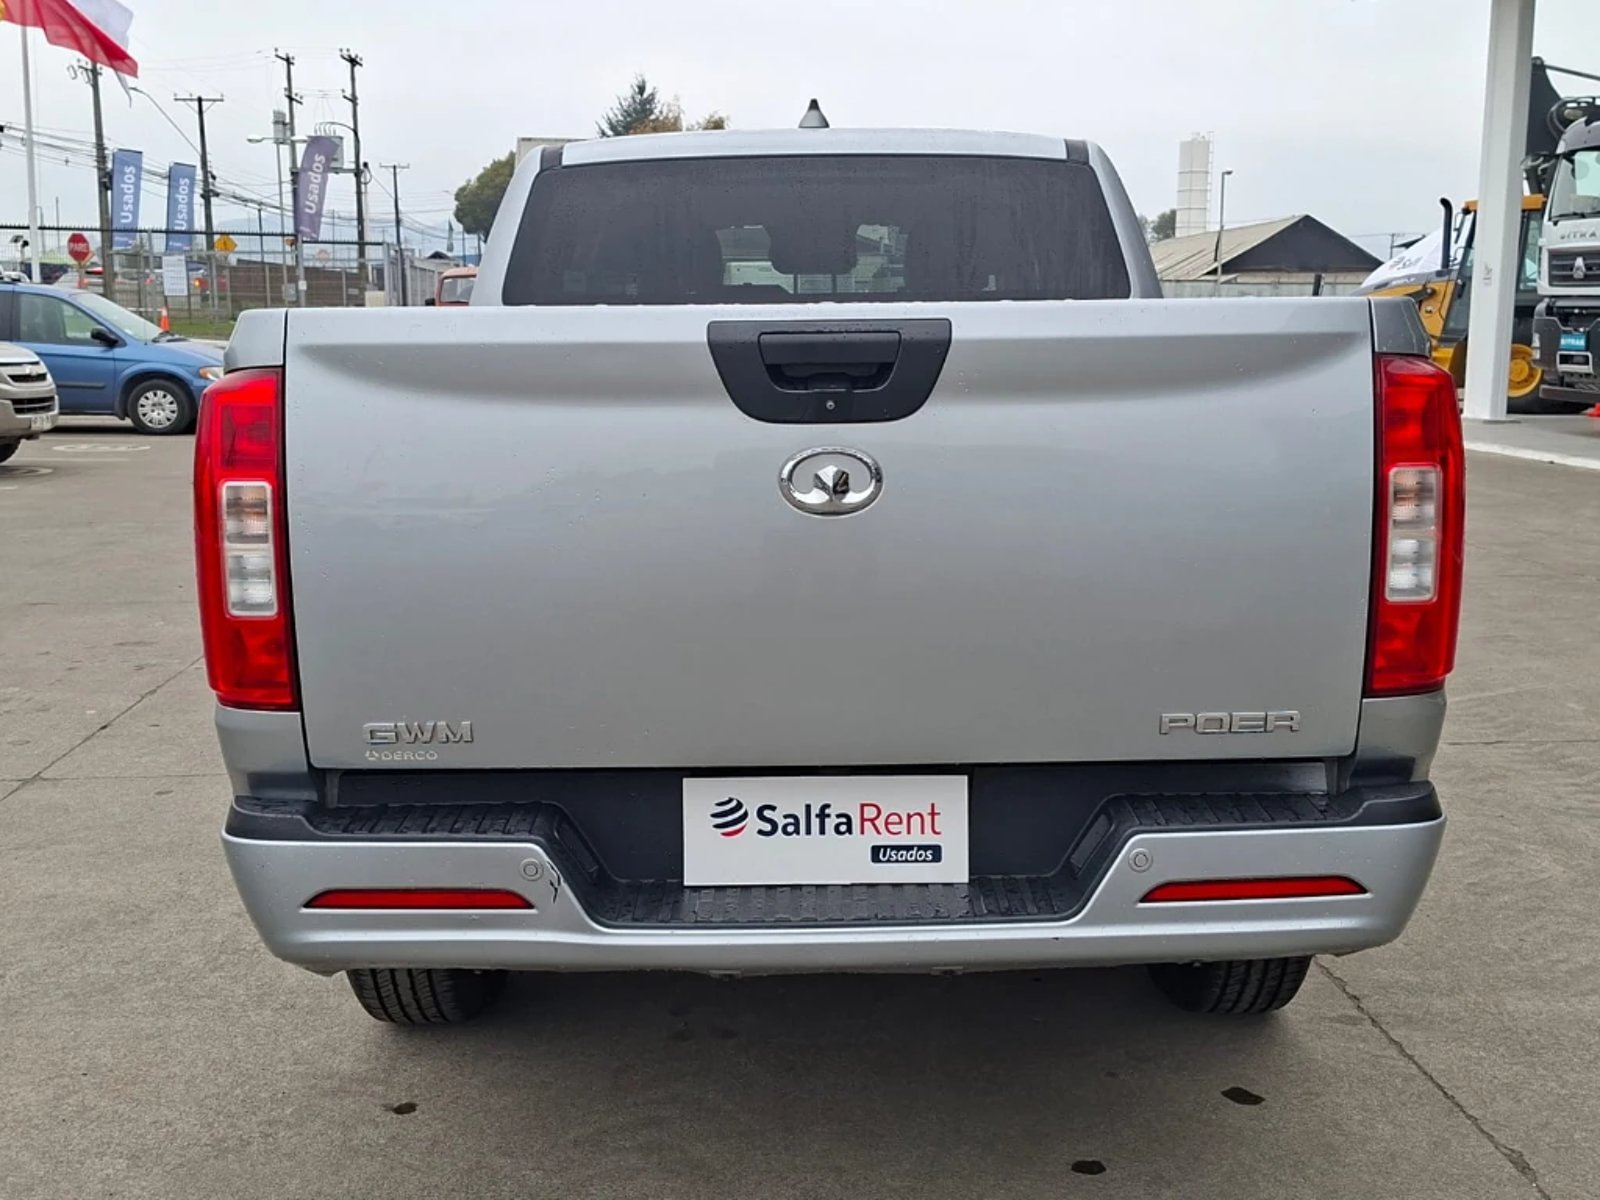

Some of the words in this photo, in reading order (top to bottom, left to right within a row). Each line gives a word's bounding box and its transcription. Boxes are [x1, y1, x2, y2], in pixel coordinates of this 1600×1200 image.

[120, 165, 136, 223] Usados
[305, 153, 325, 214] Usados
[174, 177, 190, 230] Usados
[362, 720, 475, 745] GWM
[1159, 710, 1301, 735] POER
[381, 751, 438, 761] DERCO
[755, 802, 942, 838] SalfaRent
[878, 846, 934, 862] Usados
